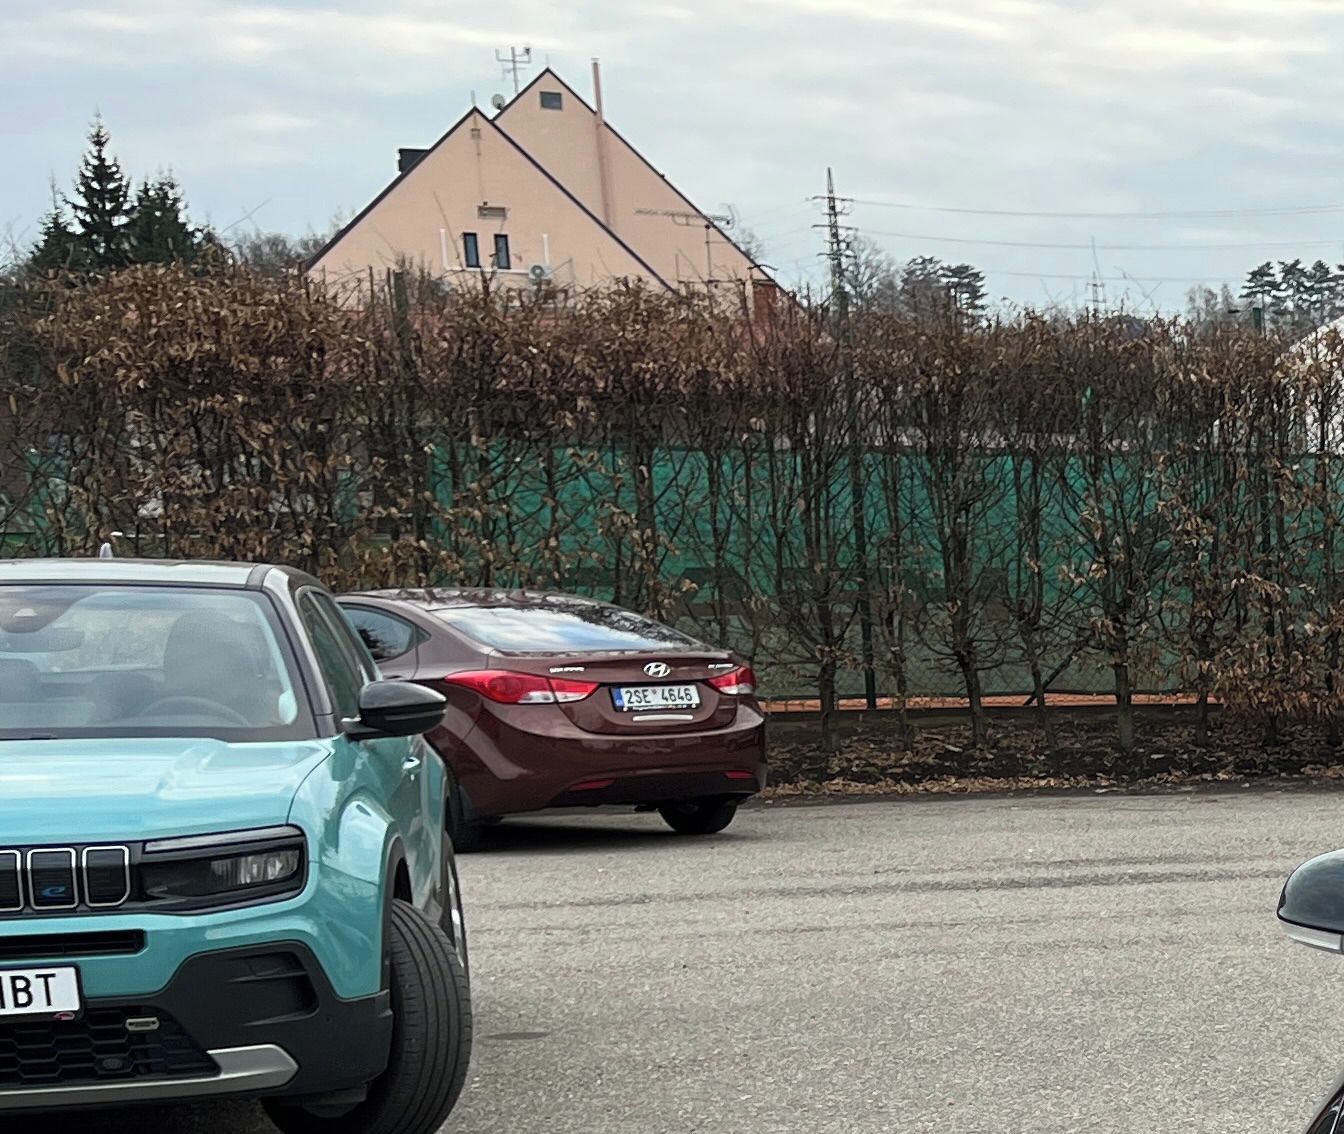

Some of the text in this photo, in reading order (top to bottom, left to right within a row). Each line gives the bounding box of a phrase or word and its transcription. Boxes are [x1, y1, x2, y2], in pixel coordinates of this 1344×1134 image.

[624, 688, 651, 705] 2SE
[660, 686, 694, 703] 4646
[0, 972, 57, 1009] BT
